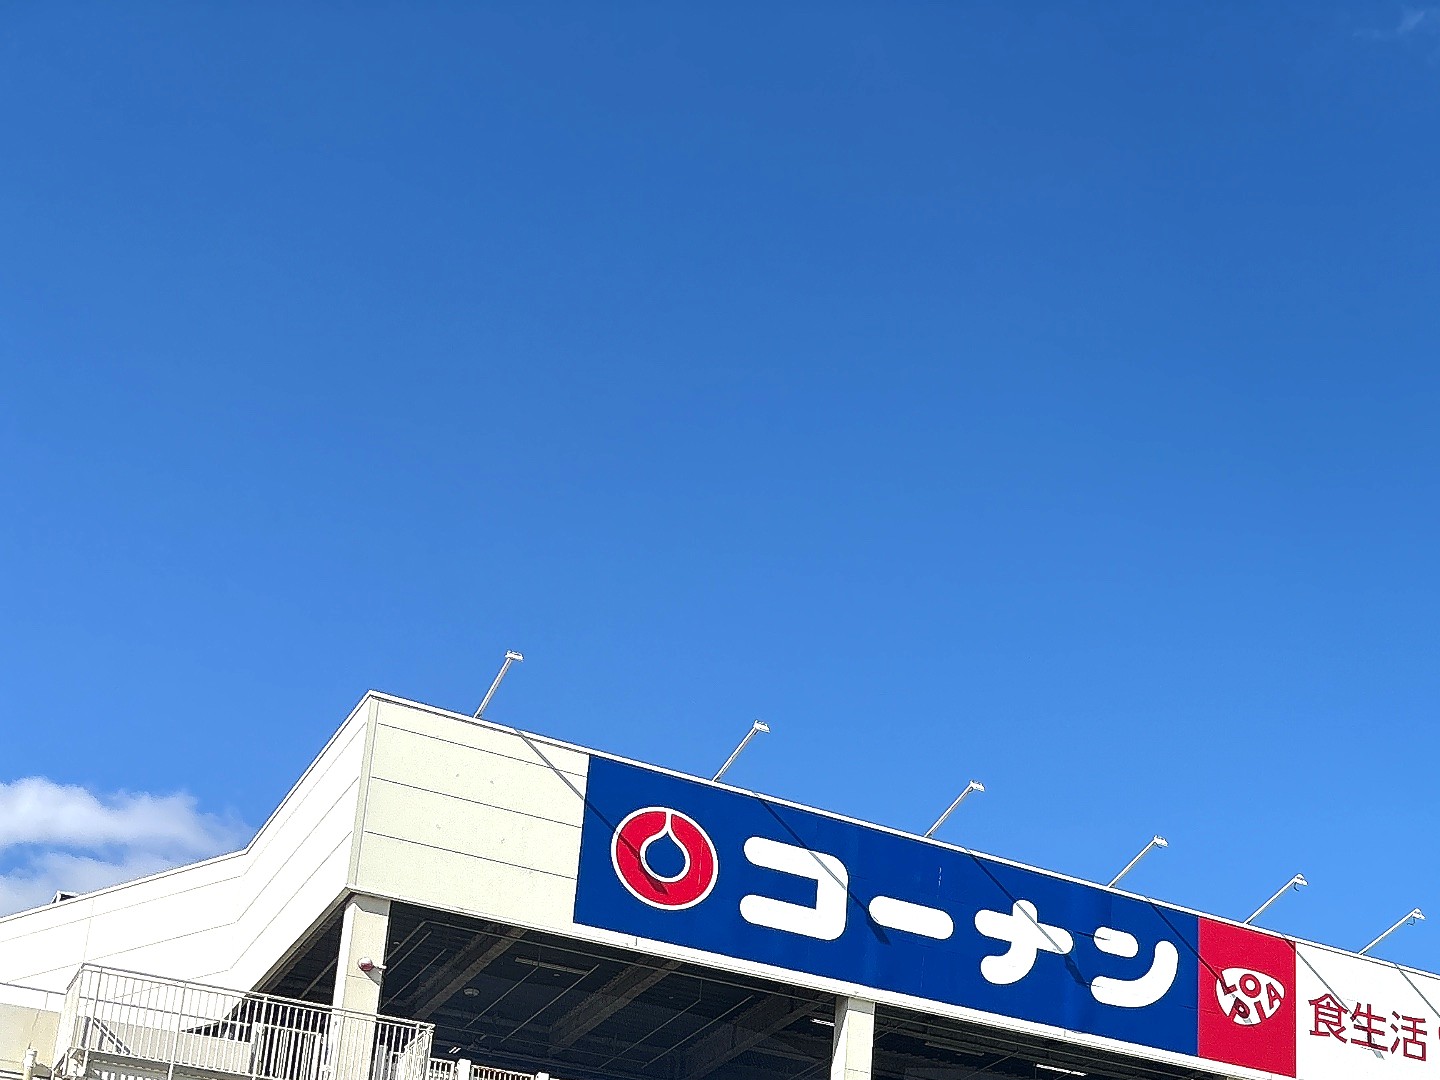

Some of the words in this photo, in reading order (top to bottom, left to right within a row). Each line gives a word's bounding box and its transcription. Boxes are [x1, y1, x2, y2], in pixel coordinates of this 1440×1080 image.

[739, 836, 1180, 1008] コーナン
[1308, 993, 1427, 1062] 食生活
